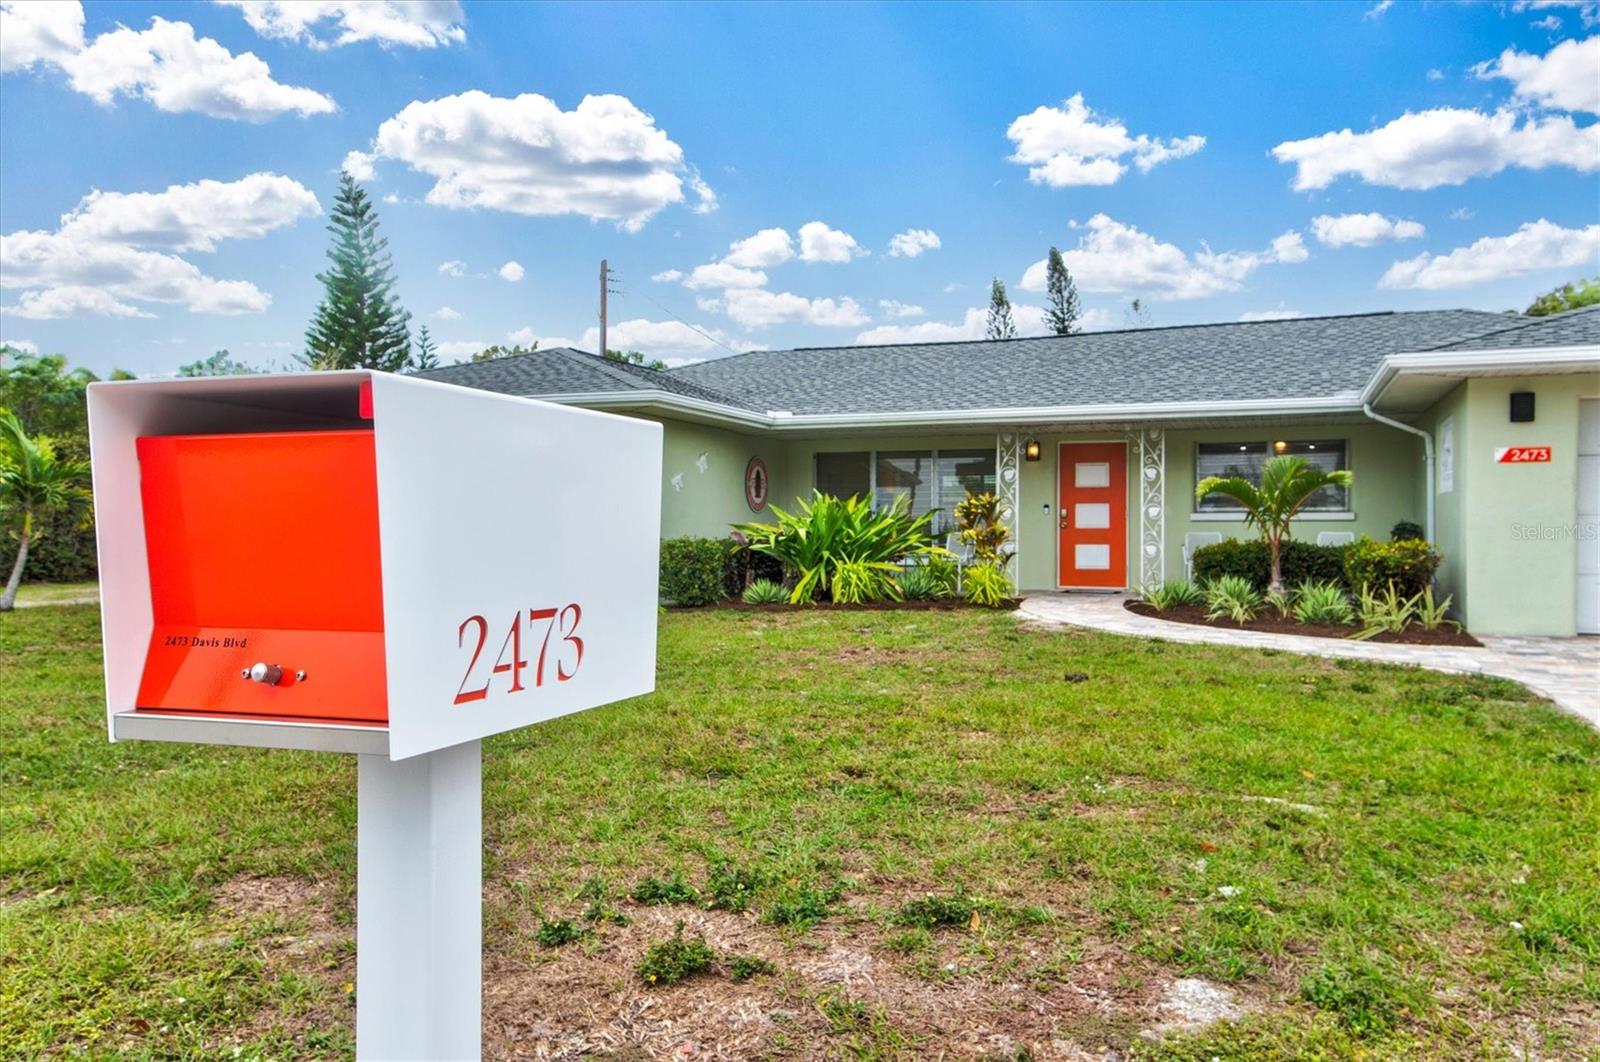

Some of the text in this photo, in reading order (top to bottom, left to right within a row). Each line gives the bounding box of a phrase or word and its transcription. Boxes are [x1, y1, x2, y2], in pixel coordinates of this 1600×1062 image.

[1510, 448, 1549, 461] 2473
[164, 636, 247, 648] 2473 Davis Blvd
[453, 603, 584, 705] 2473
